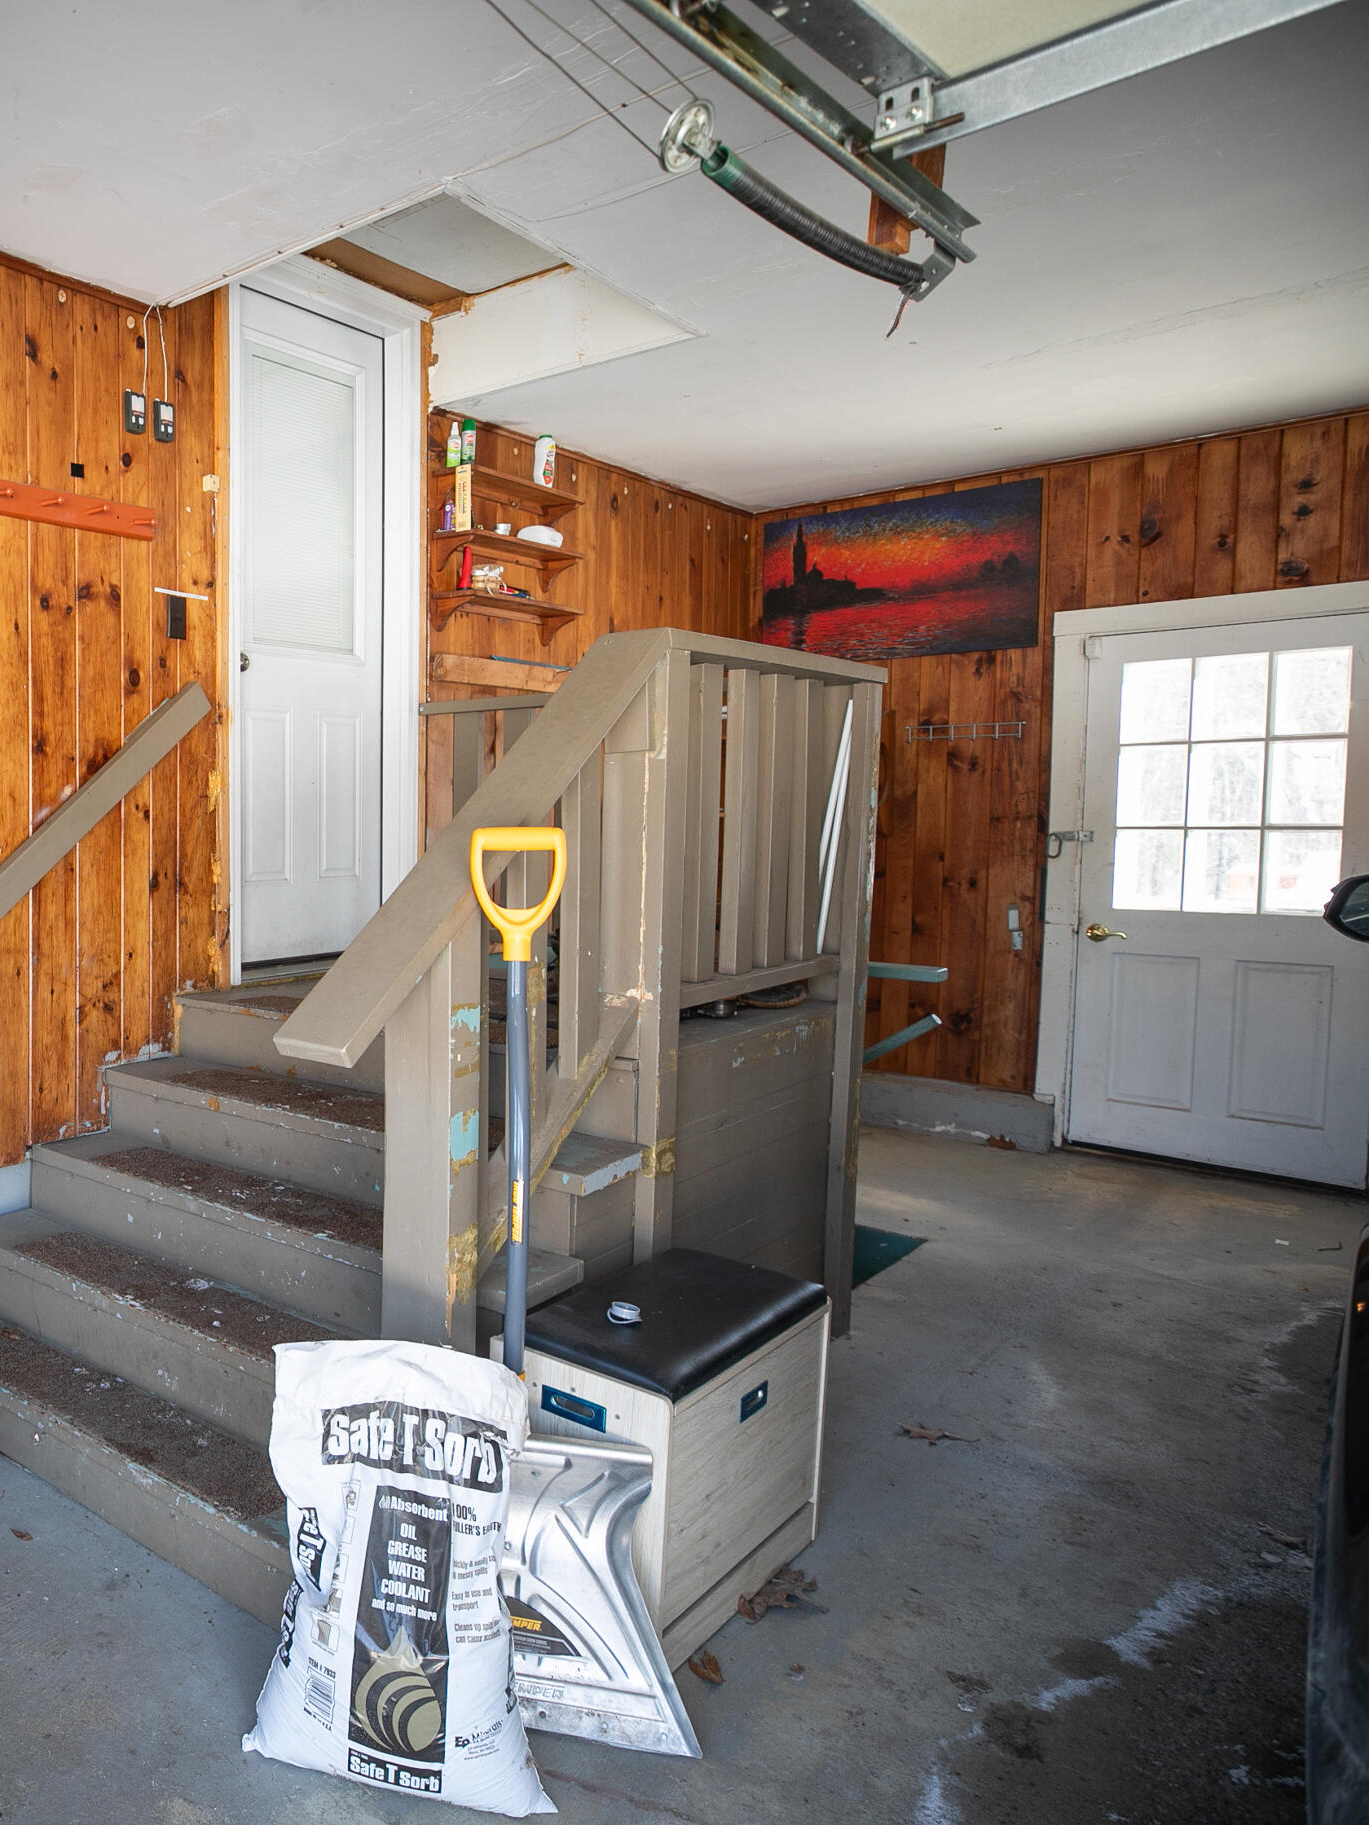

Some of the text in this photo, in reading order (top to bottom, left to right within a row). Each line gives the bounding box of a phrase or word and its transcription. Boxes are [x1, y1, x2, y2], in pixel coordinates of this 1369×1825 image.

[328, 1410, 497, 1484] Safe T Sorb
[452, 1503, 477, 1522] 100%
[400, 1522, 417, 1540] OIL
[387, 1539, 428, 1563] GREASE
[388, 1559, 426, 1582] WATER
[380, 1578, 431, 1603] COOLANT
[451, 1591, 464, 1600] Easy
[371, 1598, 438, 1622] and so much more
[349, 1755, 385, 1781] Safe
[385, 1763, 399, 1784] T
[398, 1770, 439, 1792] Sorb
